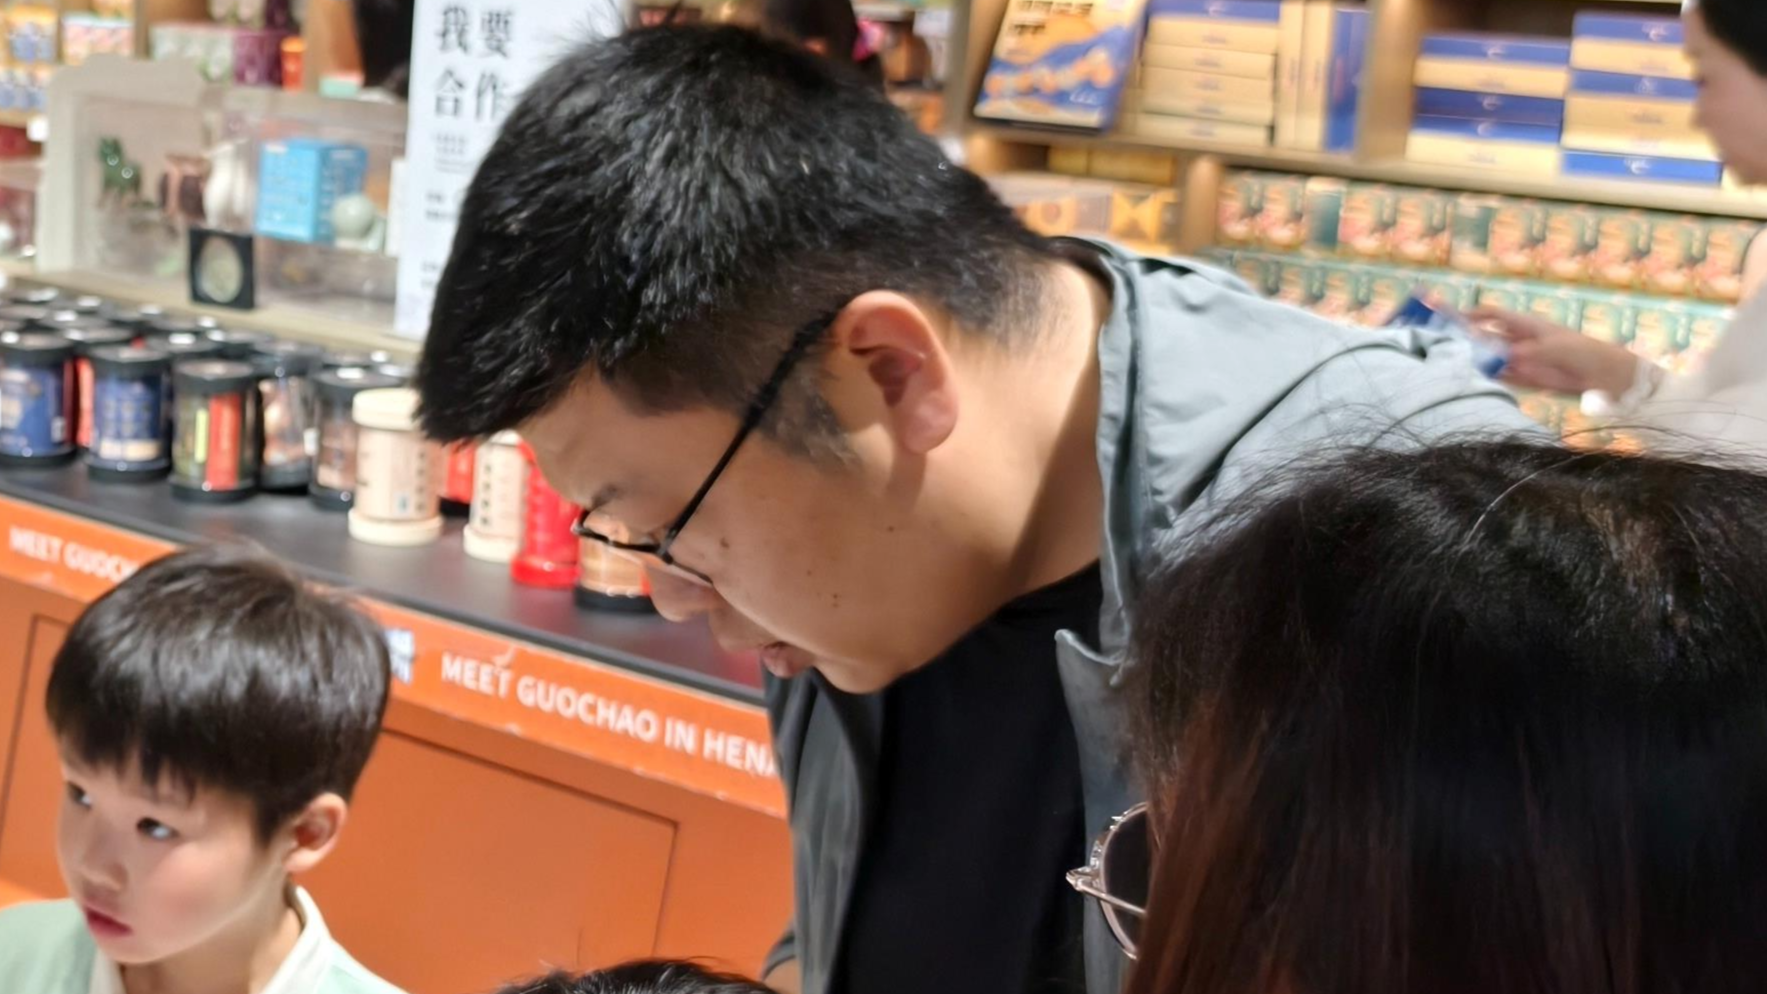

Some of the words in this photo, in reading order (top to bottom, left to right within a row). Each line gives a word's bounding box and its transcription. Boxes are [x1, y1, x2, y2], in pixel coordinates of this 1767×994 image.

[436, 5, 513, 58] 我要
[434, 68, 511, 121] 合作
[9, 526, 63, 564] MEET
[441, 651, 512, 698] MEET
[516, 674, 659, 743] GUOCHAO
[663, 716, 698, 756] IN
